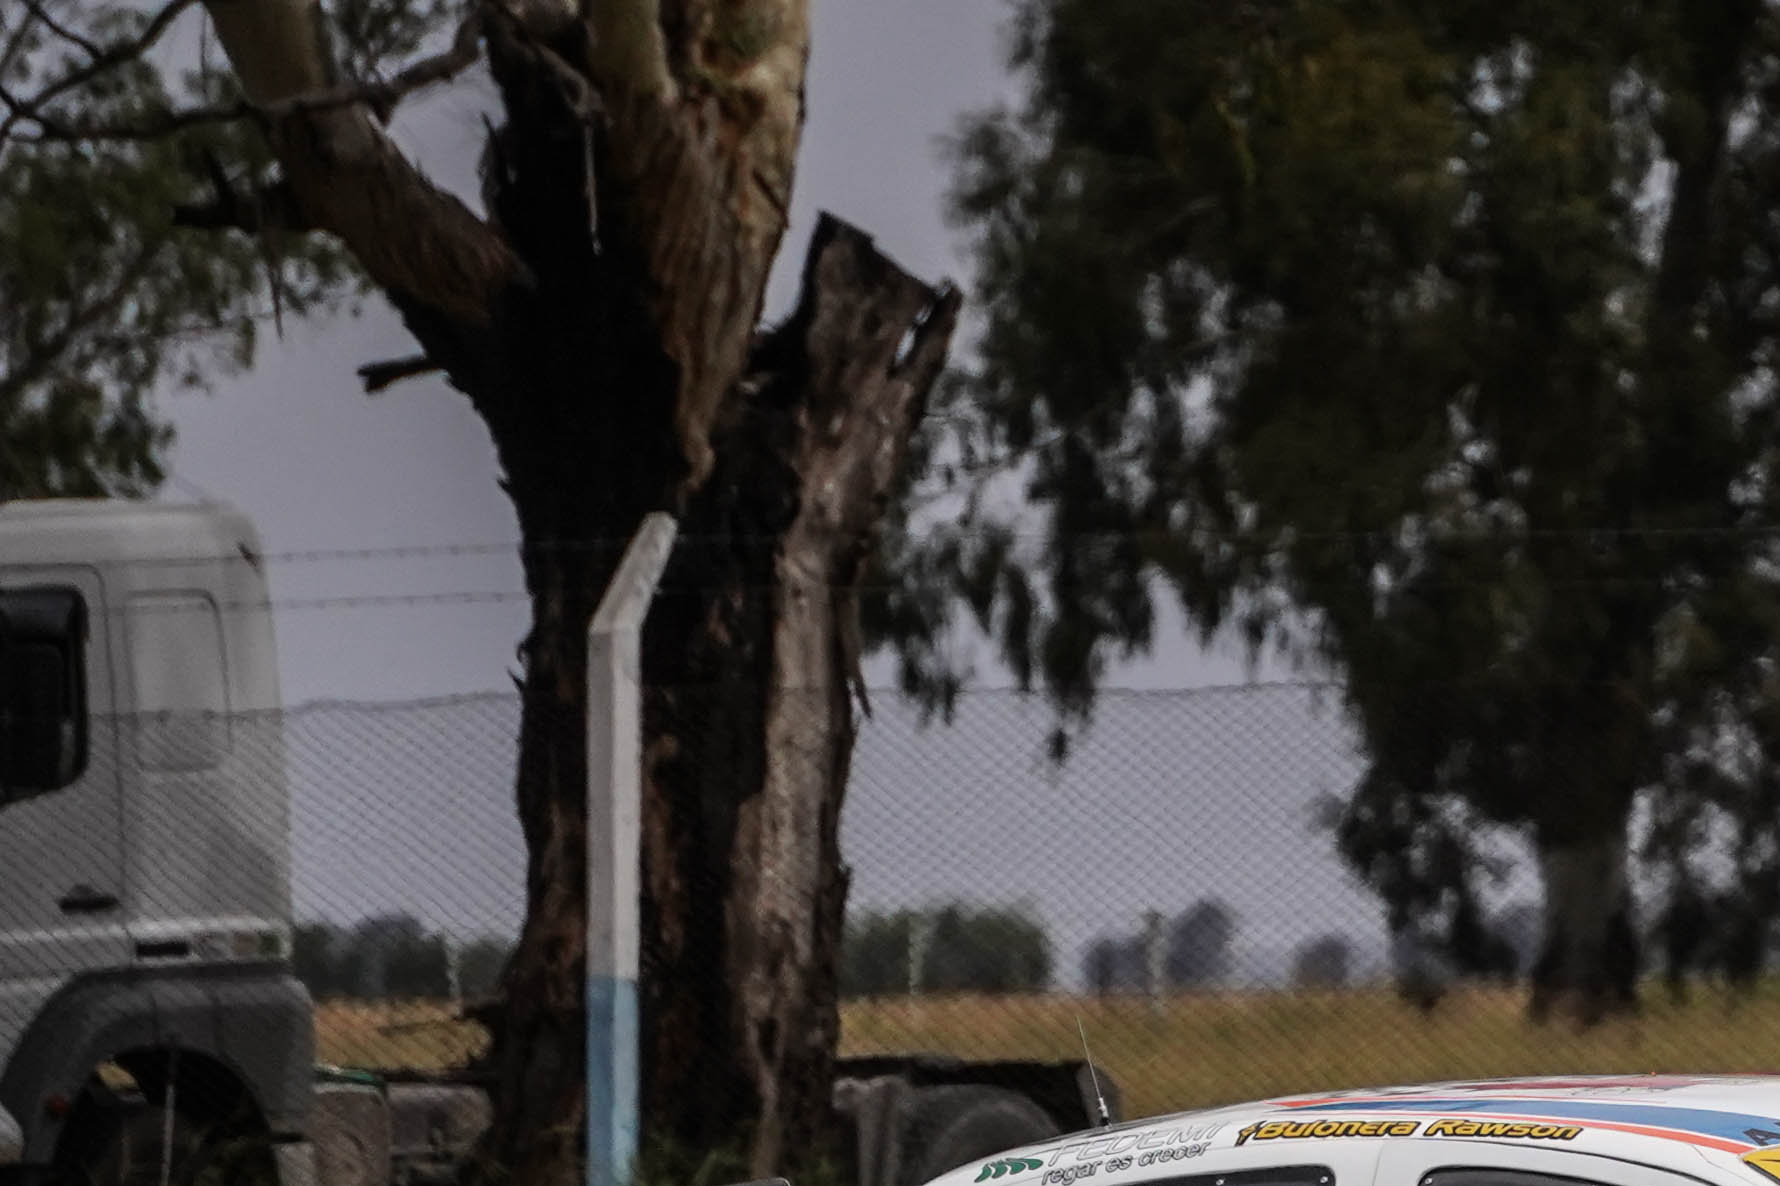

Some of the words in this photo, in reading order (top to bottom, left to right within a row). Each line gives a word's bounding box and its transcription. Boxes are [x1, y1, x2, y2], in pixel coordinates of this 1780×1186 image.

[1255, 1119, 1421, 1139] Bulonera
[1423, 1118, 1583, 1140] Rawson
[1041, 1160, 1102, 1186] regar
[1105, 1153, 1132, 1173] es
[1138, 1140, 1212, 1167] crecer
